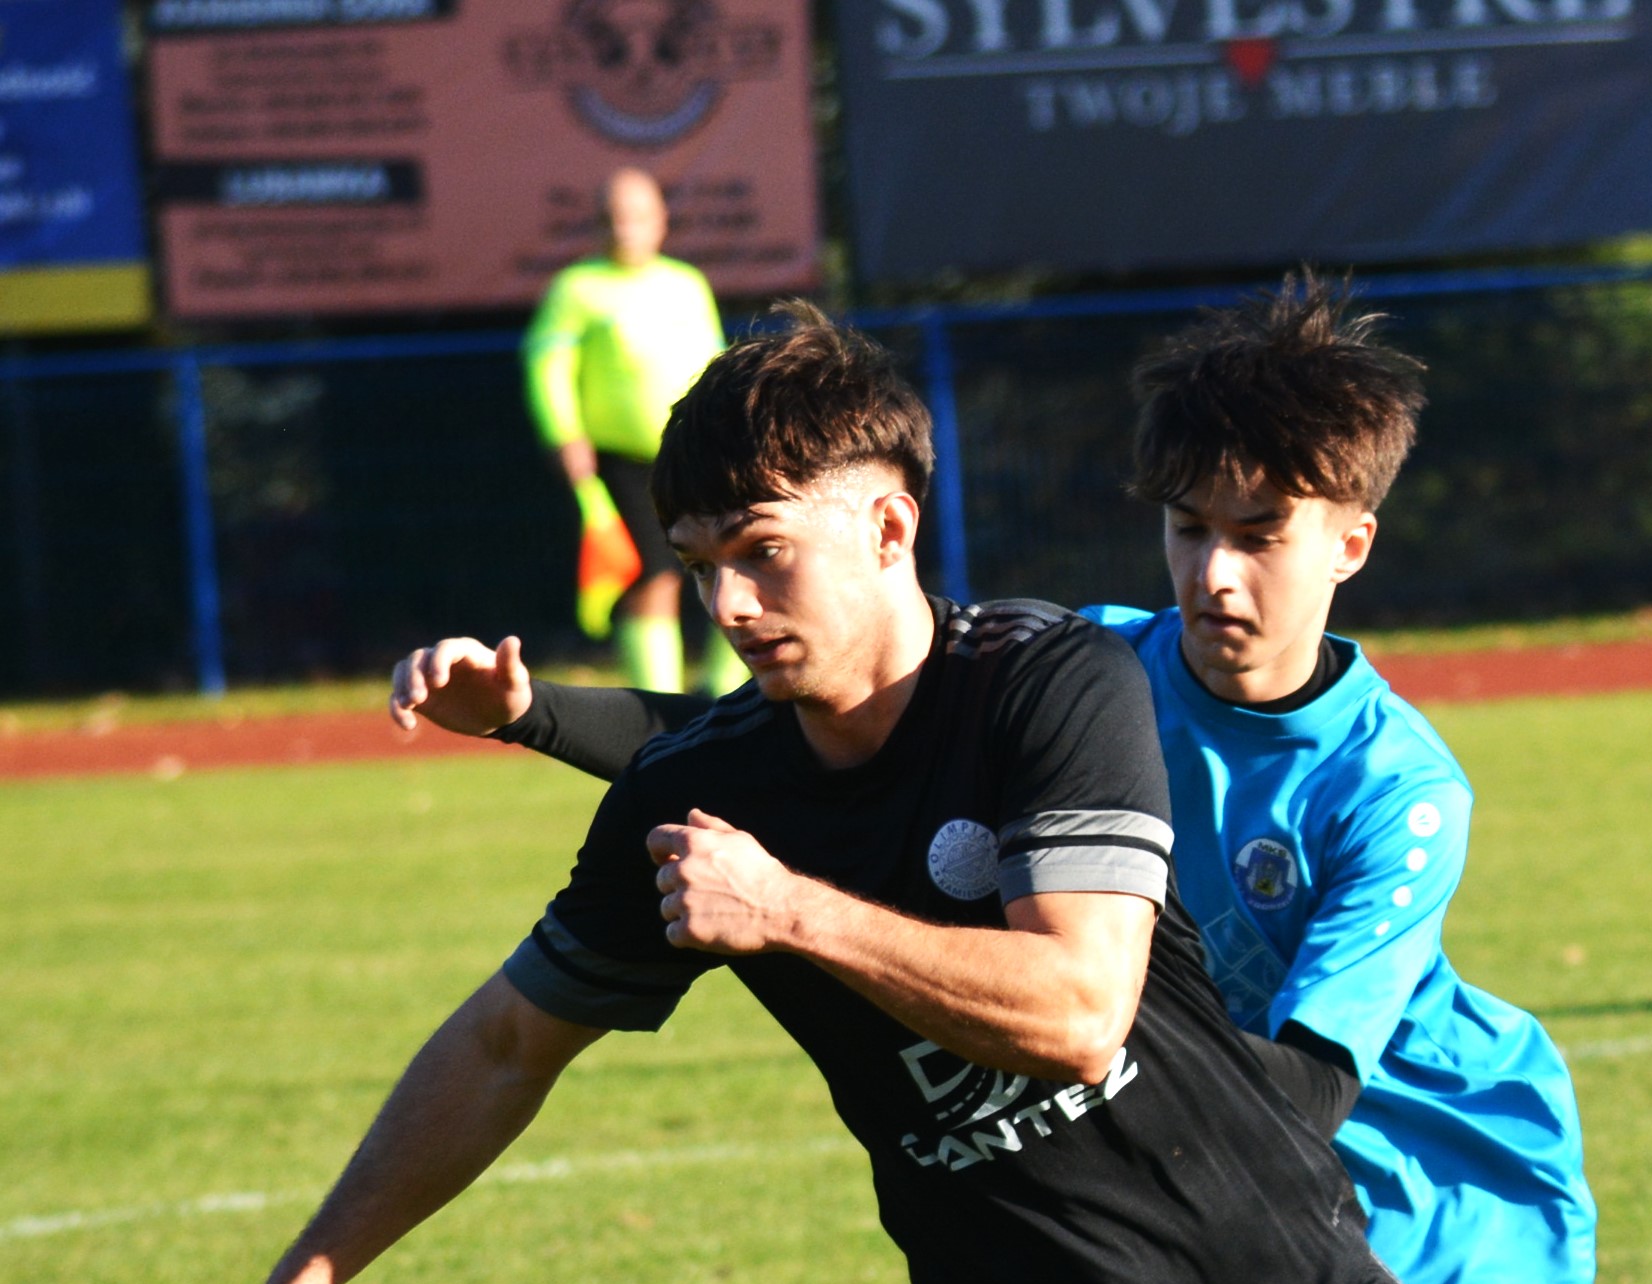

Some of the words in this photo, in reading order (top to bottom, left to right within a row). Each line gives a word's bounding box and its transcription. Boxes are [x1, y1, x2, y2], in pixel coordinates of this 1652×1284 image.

[1025, 70, 1246, 136] TWOJE
[1267, 58, 1498, 119] MEBLE
[930, 821, 990, 864] OLIMPIA
